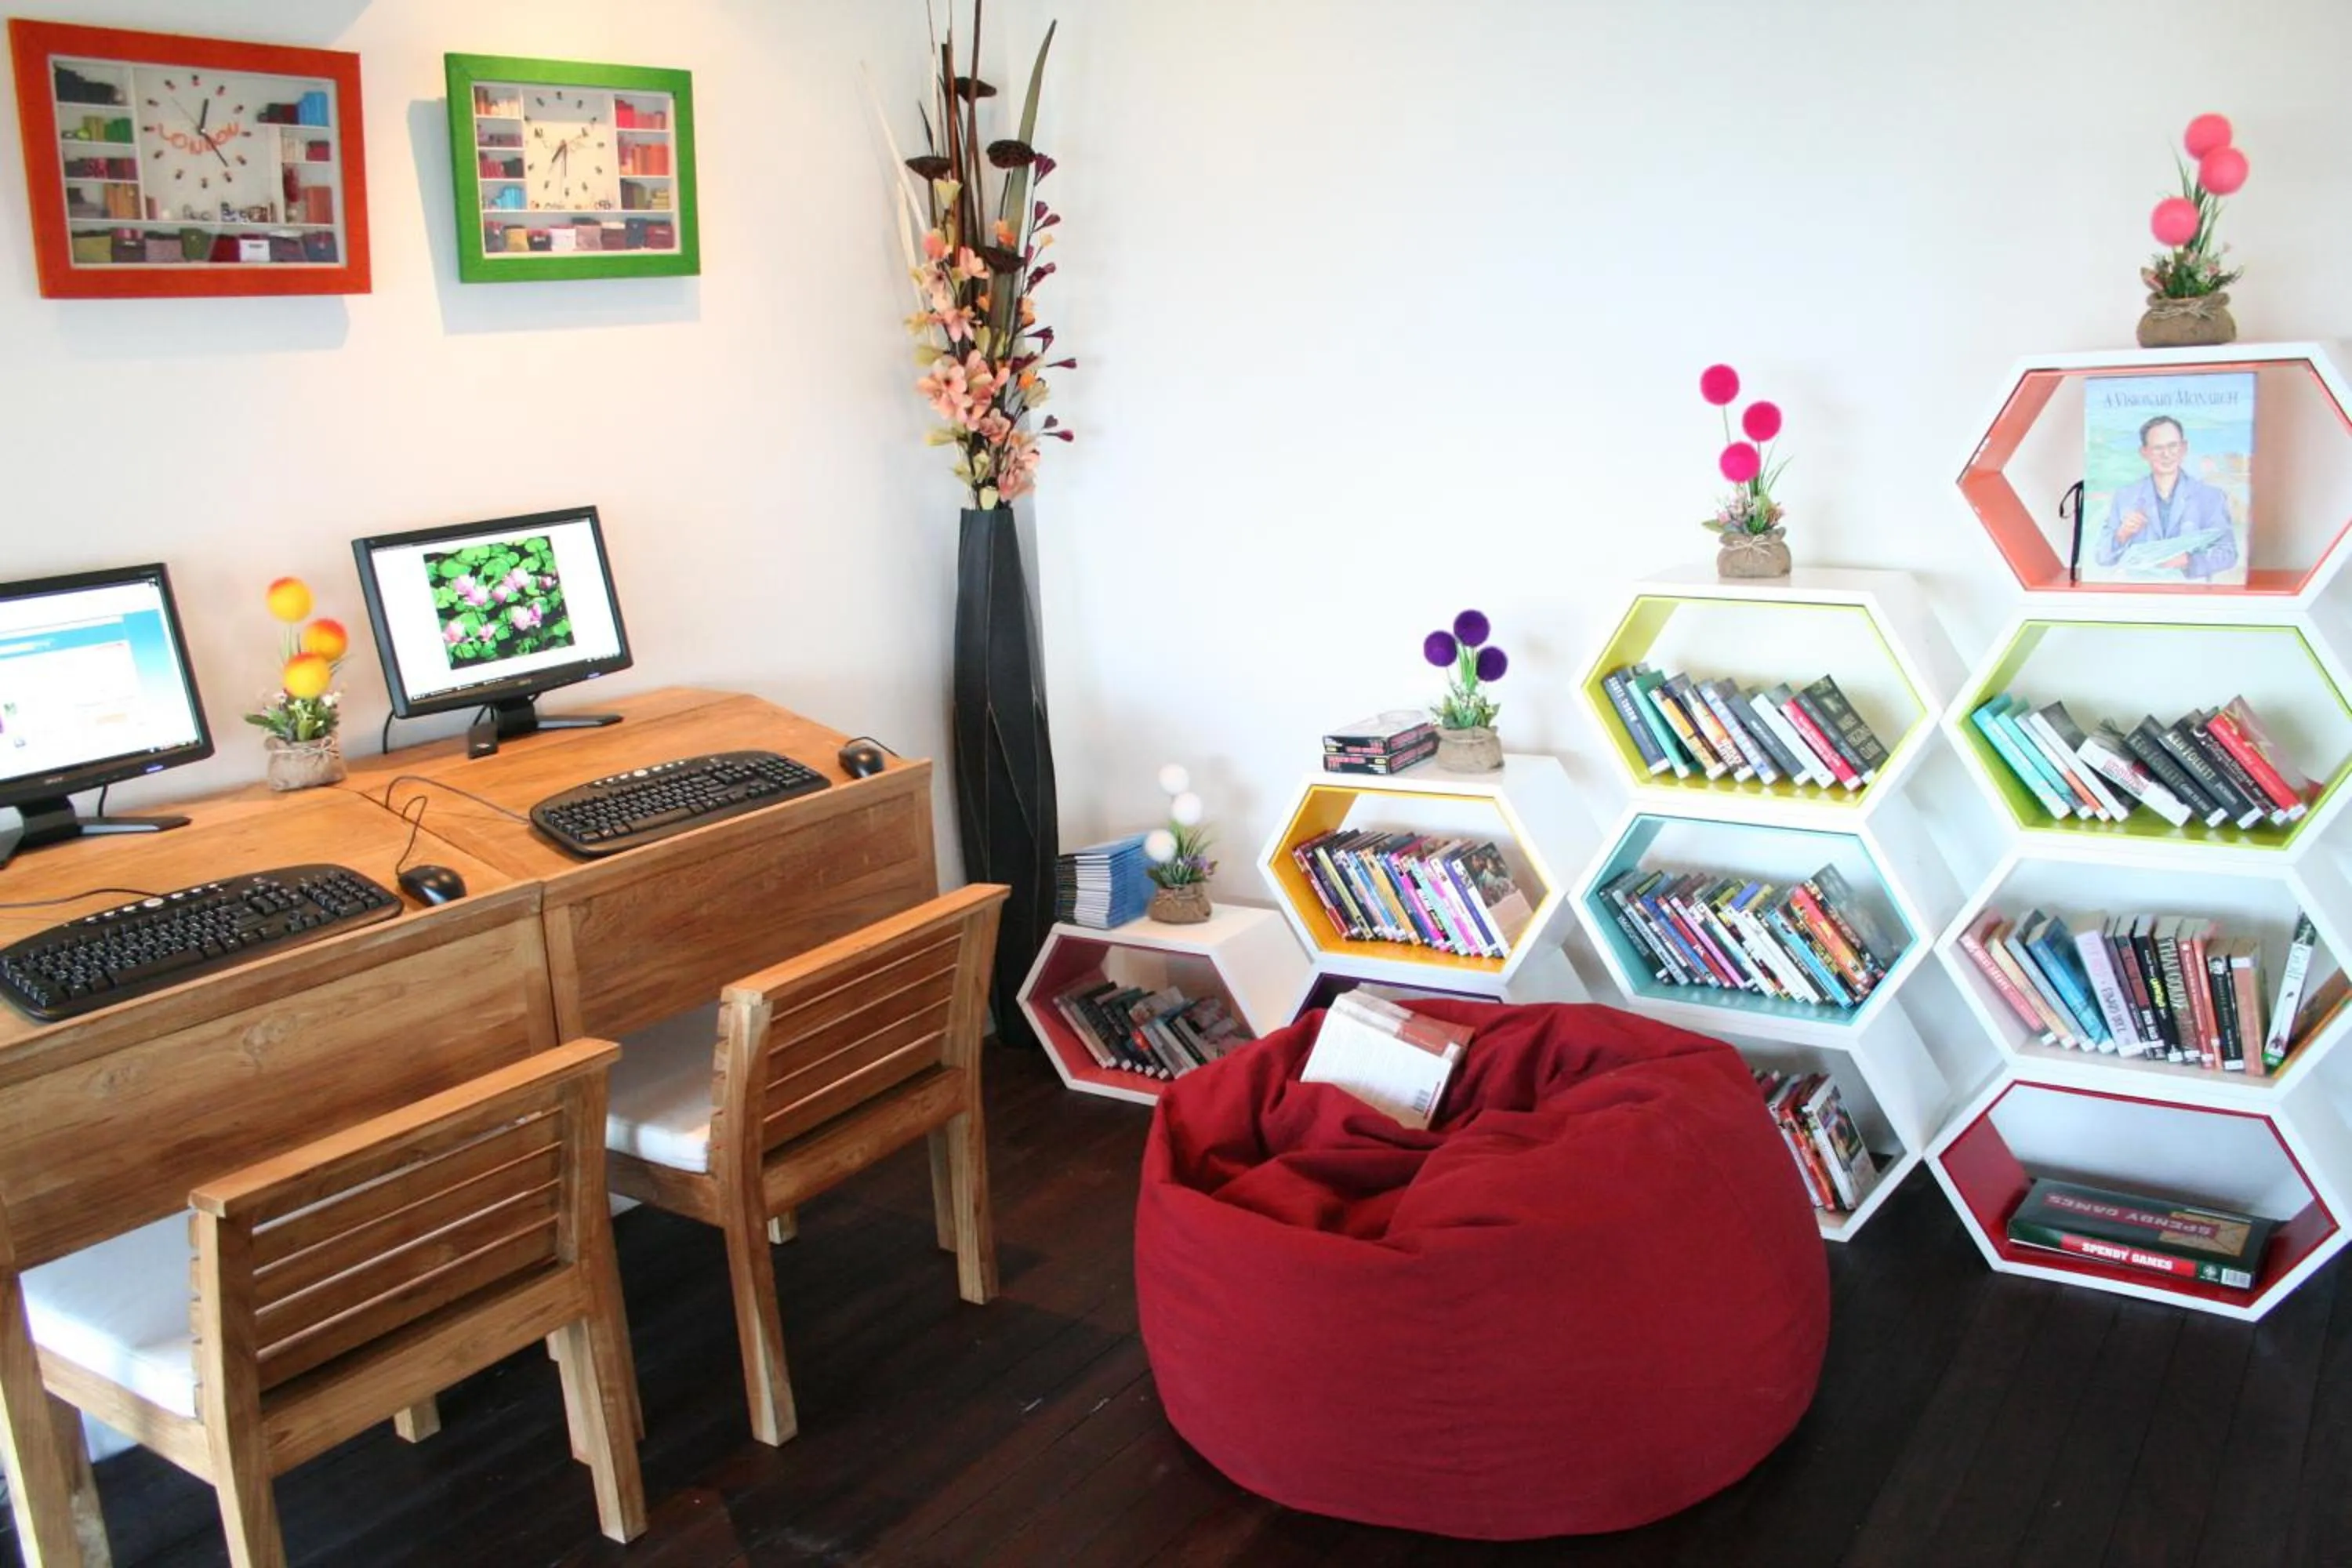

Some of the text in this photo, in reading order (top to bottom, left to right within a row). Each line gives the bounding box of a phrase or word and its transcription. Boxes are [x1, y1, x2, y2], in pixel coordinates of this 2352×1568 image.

[2173, 388, 2239, 405] MONARCH
[2156, 938, 2180, 971] THAI
[2047, 1192, 2212, 1236] SPENDY GAMES
[2082, 1242, 2173, 1271] SPENDY GAMES
